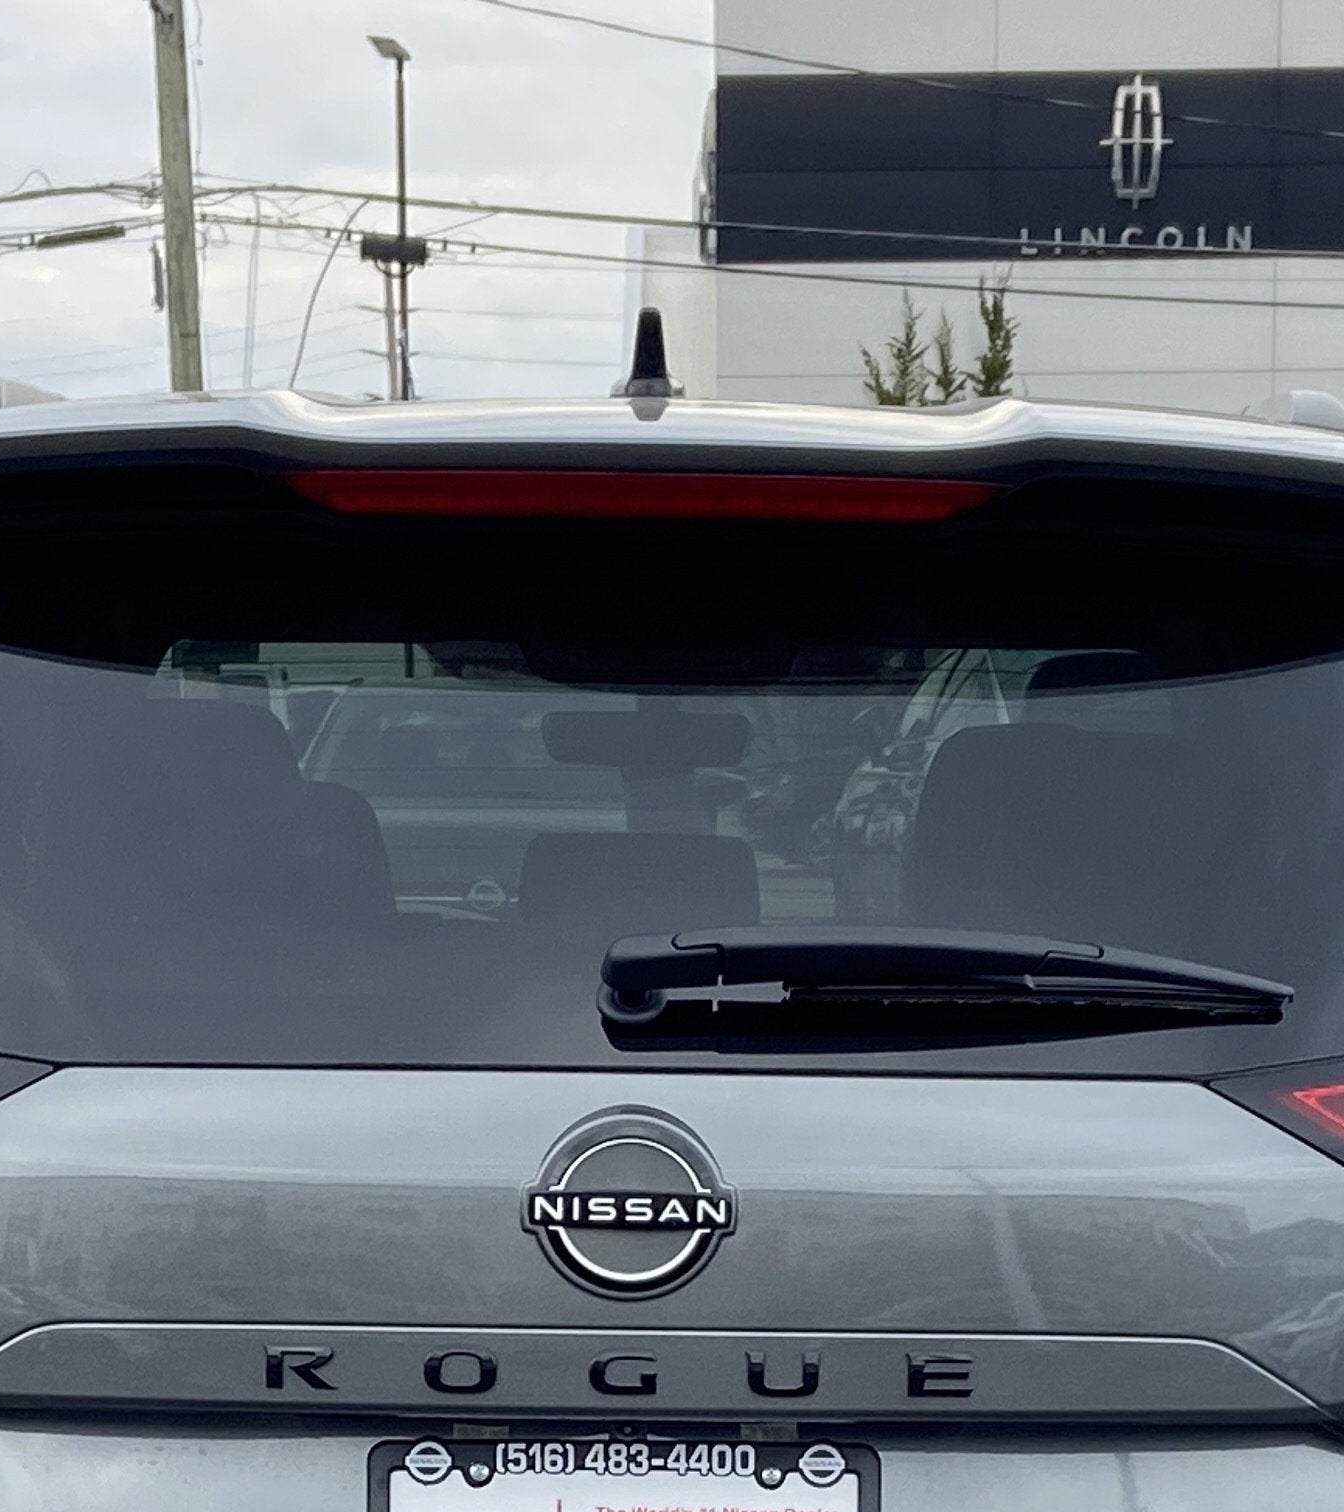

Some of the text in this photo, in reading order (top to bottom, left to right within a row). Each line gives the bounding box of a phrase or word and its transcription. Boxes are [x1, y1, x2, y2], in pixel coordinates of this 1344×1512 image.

[1019, 225, 1253, 256] LINCOLN
[534, 1196, 726, 1224] NISSAN
[263, 1344, 975, 1399] ROGUE
[494, 1442, 756, 1476] (516) 483-4400
